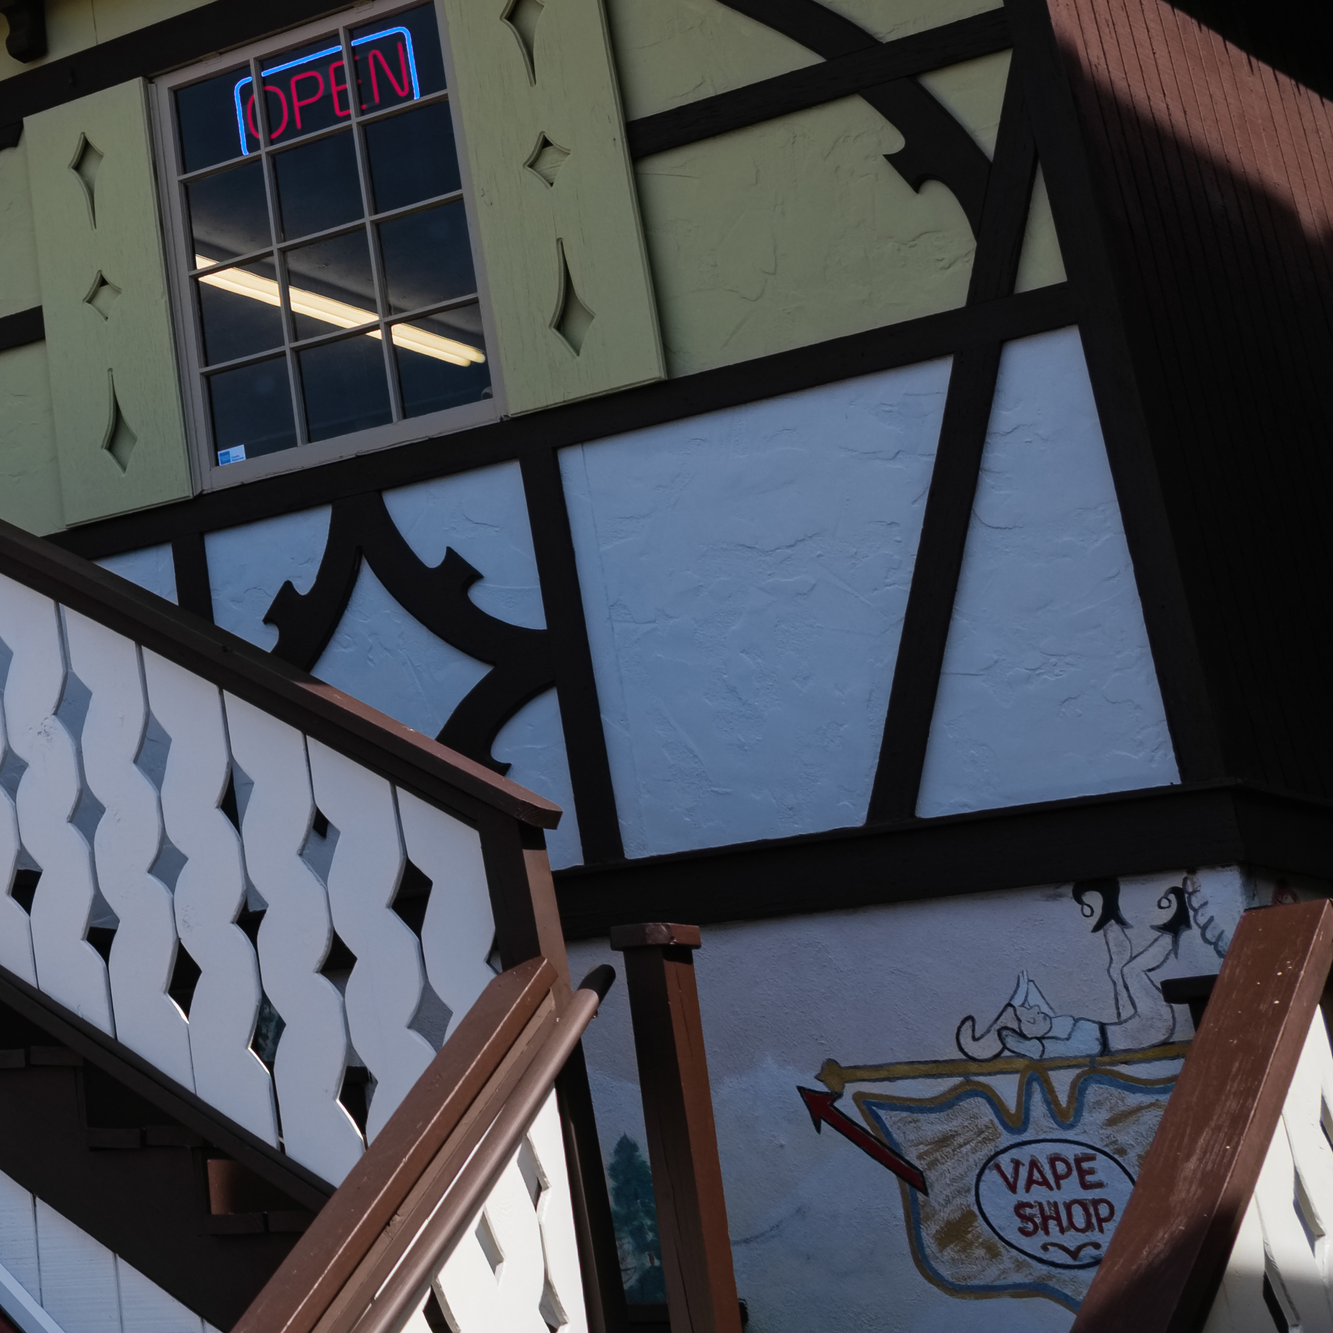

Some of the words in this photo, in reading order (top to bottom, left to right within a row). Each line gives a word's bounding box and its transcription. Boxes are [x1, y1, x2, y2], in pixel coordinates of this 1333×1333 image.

[246, 41, 410, 141] OPEN
[989, 1152, 1107, 1195] VAPE
[1013, 1197, 1116, 1238] SHOP
